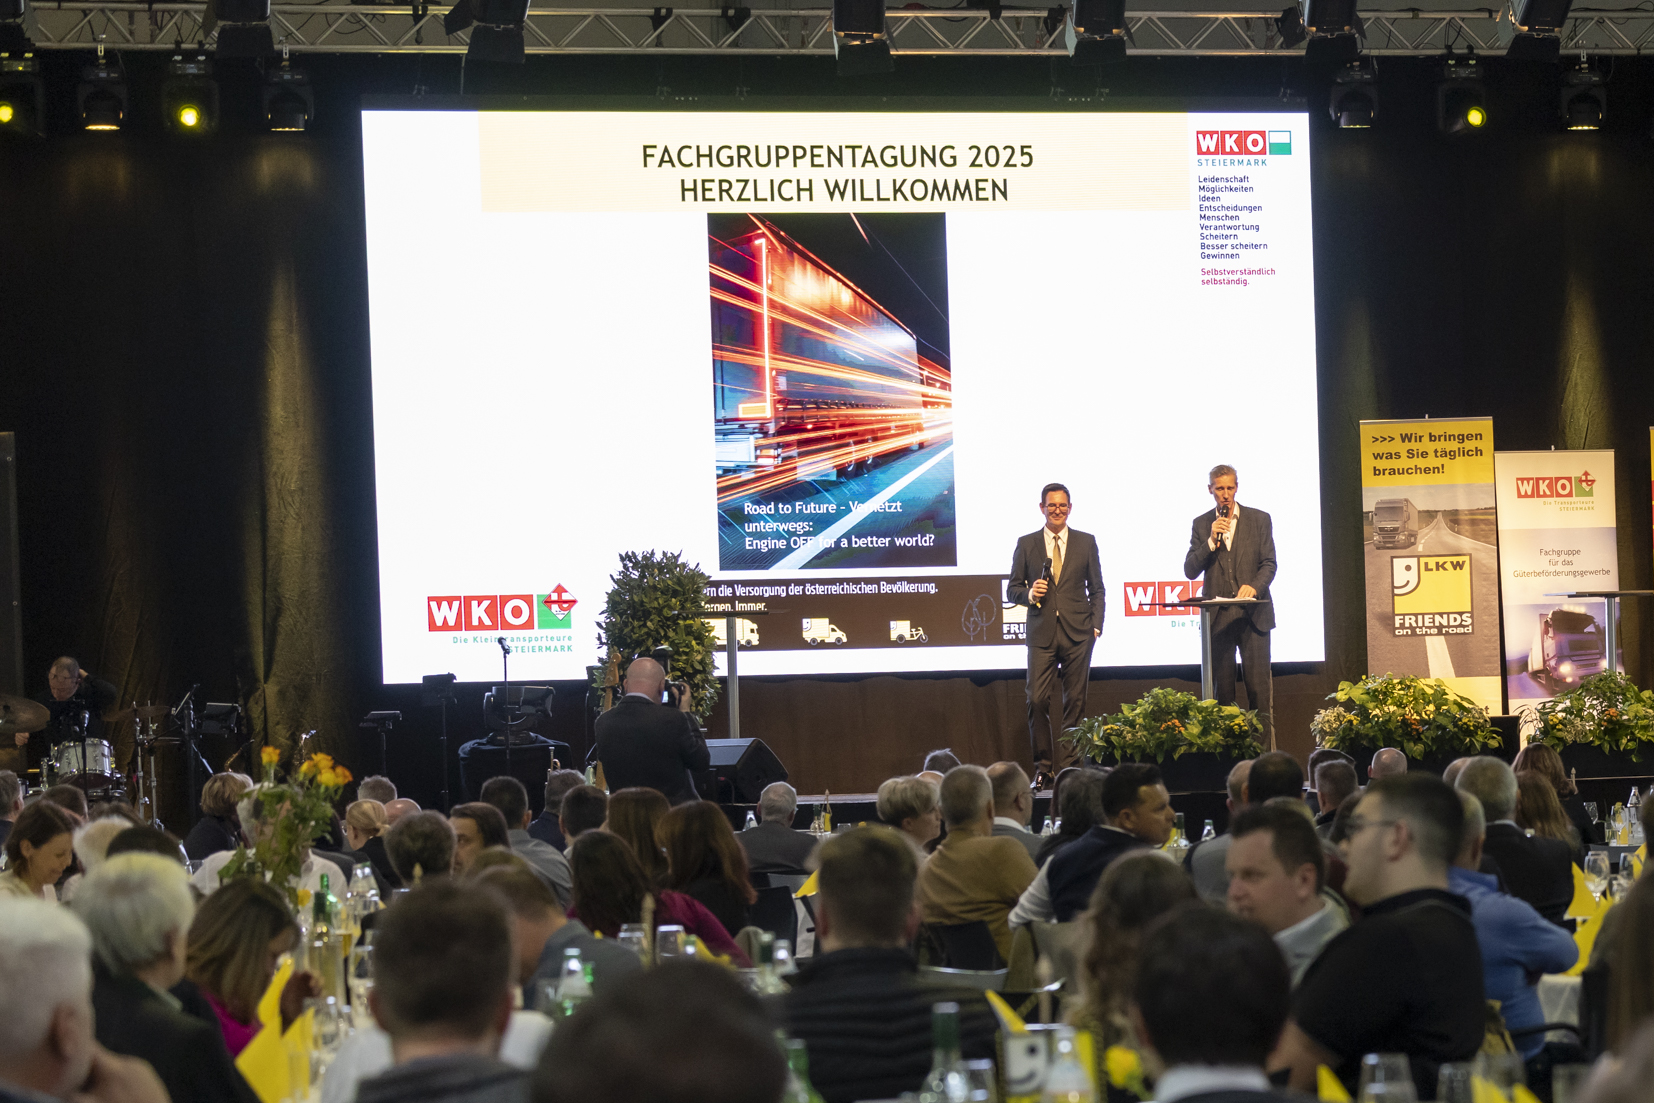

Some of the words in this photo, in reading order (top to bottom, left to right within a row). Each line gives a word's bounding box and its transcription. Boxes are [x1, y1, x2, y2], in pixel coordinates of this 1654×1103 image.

[1197, 133, 1264, 153] WKO
[642, 145, 957, 168] FACHGRUPPENTAGUNG
[969, 145, 1034, 168] 2025
[1197, 159, 1268, 167] STEIERMARK
[1198, 175, 1250, 183] Leidenschaft
[680, 179, 813, 202] HERZLICH
[824, 178, 1009, 202] WILLKOMMEN
[1199, 185, 1254, 194] Möglichkeiten
[1199, 194, 1221, 203] Ideen
[1199, 204, 1263, 213] Entscheidungen
[1200, 214, 1240, 222] Menschen
[1200, 223, 1260, 232] Verantwortung
[1200, 233, 1239, 241] Scheitern
[1200, 242, 1229, 250] Besser
[1230, 242, 1268, 250] scheitern
[1200, 252, 1240, 260] Gewinnen
[1201, 268, 1276, 276] Selbstverständlich
[1201, 277, 1250, 287] selbständig.
[1400, 432, 1425, 443] Wir
[1428, 432, 1483, 444] bringen
[1372, 451, 1402, 460] was
[1406, 448, 1429, 459] Sie
[1433, 447, 1483, 460] täglich
[1373, 464, 1445, 476] brauchen!
[1517, 479, 1571, 496] WKO
[744, 502, 774, 515] Road
[778, 503, 792, 515] to
[795, 501, 837, 514] Future
[745, 520, 814, 534] unterwegs:
[745, 537, 787, 552] Engine
[790, 536, 815, 549] OFF
[840, 538, 848, 547] a
[851, 535, 891, 547] better
[895, 534, 935, 547] world?
[1539, 548, 1581, 557] Fachgruppe
[1424, 560, 1466, 572] LKW
[1513, 568, 1611, 578] Güterbeförderungsgewerbe
[718, 584, 733, 596] die
[734, 584, 786, 598] Versorgung
[788, 583, 803, 595] der
[805, 581, 878, 595] österreichischen
[880, 580, 938, 596] Bevölkerung.
[701, 601, 734, 612] orgen.
[735, 600, 767, 611] Immer.
[429, 598, 530, 626] WKO
[1394, 613, 1472, 627] FRIENDS
[1395, 628, 1411, 636] on
[1416, 627, 1438, 635] the
[1442, 625, 1472, 634] road
[453, 636, 469, 644] Die
[473, 634, 573, 644] Kleinransporteure
[509, 645, 573, 654] STEIERMARK
